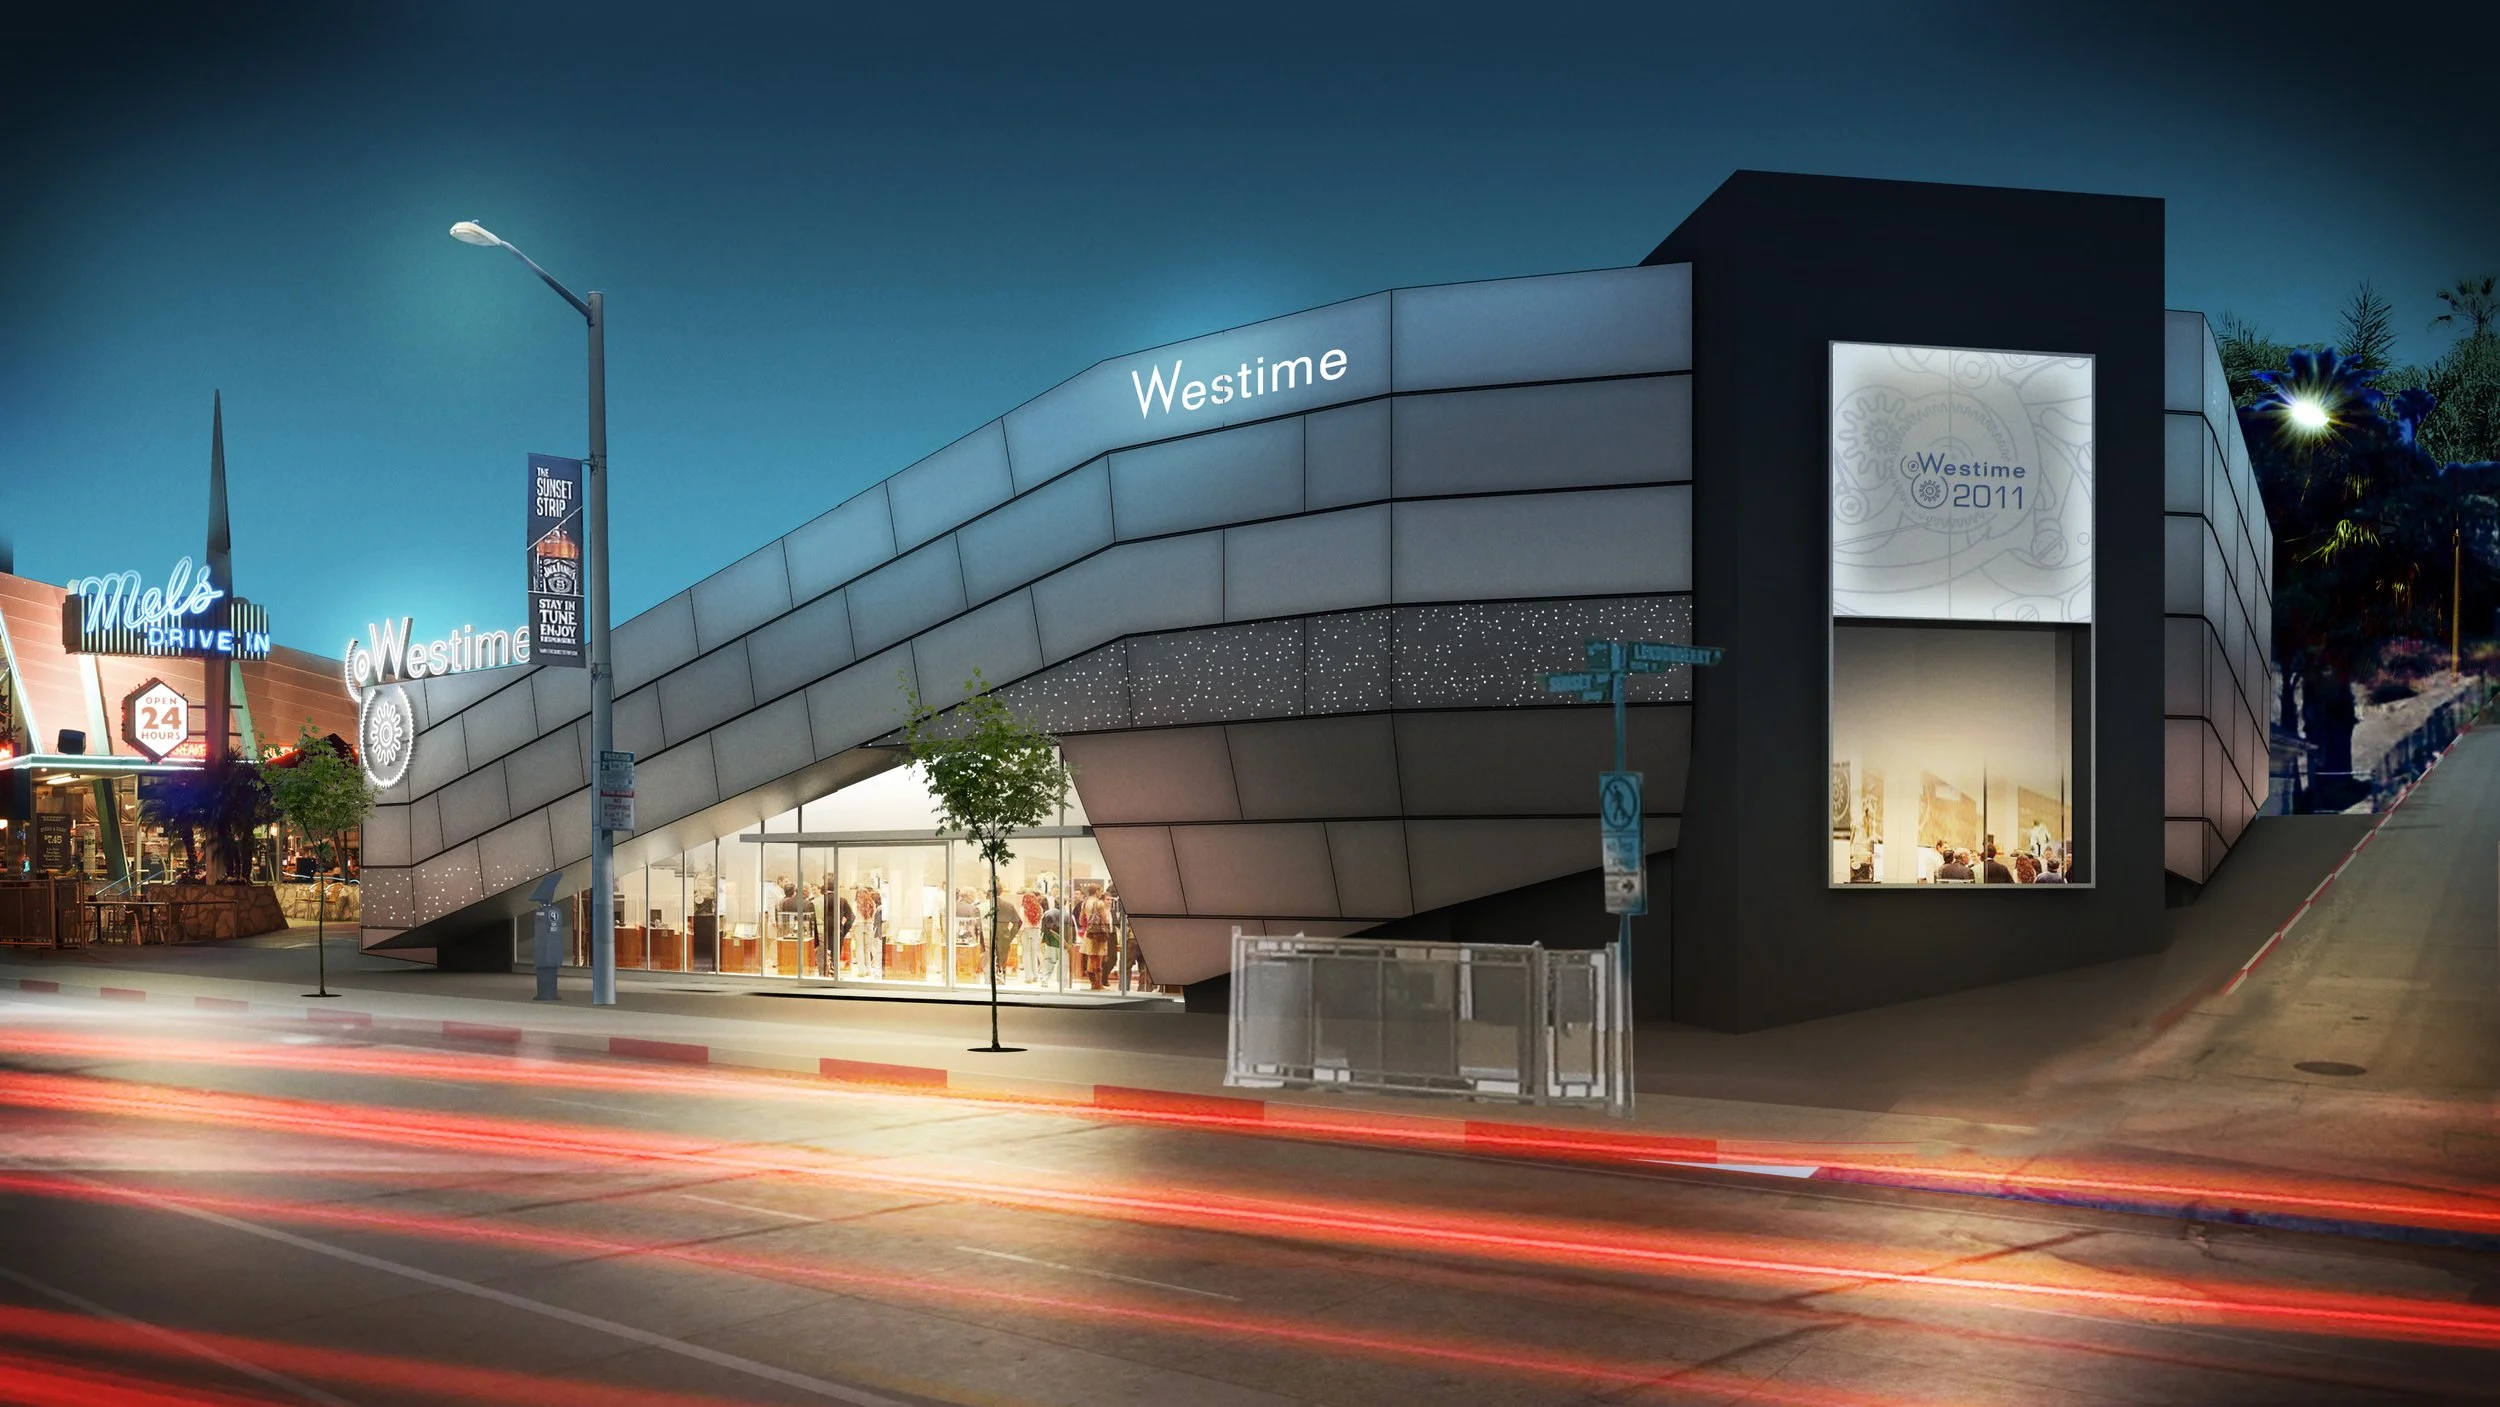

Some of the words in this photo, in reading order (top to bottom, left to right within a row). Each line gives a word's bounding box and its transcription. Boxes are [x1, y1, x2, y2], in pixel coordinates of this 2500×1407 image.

[1131, 349, 1348, 420] Westime
[536, 466, 549, 477] THE
[1916, 451, 2026, 479] Westime
[536, 478, 573, 500] SUNSET
[1953, 484, 2023, 510] 2011
[536, 497, 566, 518] STRIP
[539, 599, 564, 610] STAY
[564, 601, 575, 611] IN
[148, 627, 232, 651] DRIVE
[245, 631, 271, 652] IN
[540, 624, 576, 638] ENJOY
[368, 616, 531, 683] Westime
[145, 696, 177, 705] OPEN
[141, 707, 182, 730] 24
[141, 731, 181, 740] HOURS
